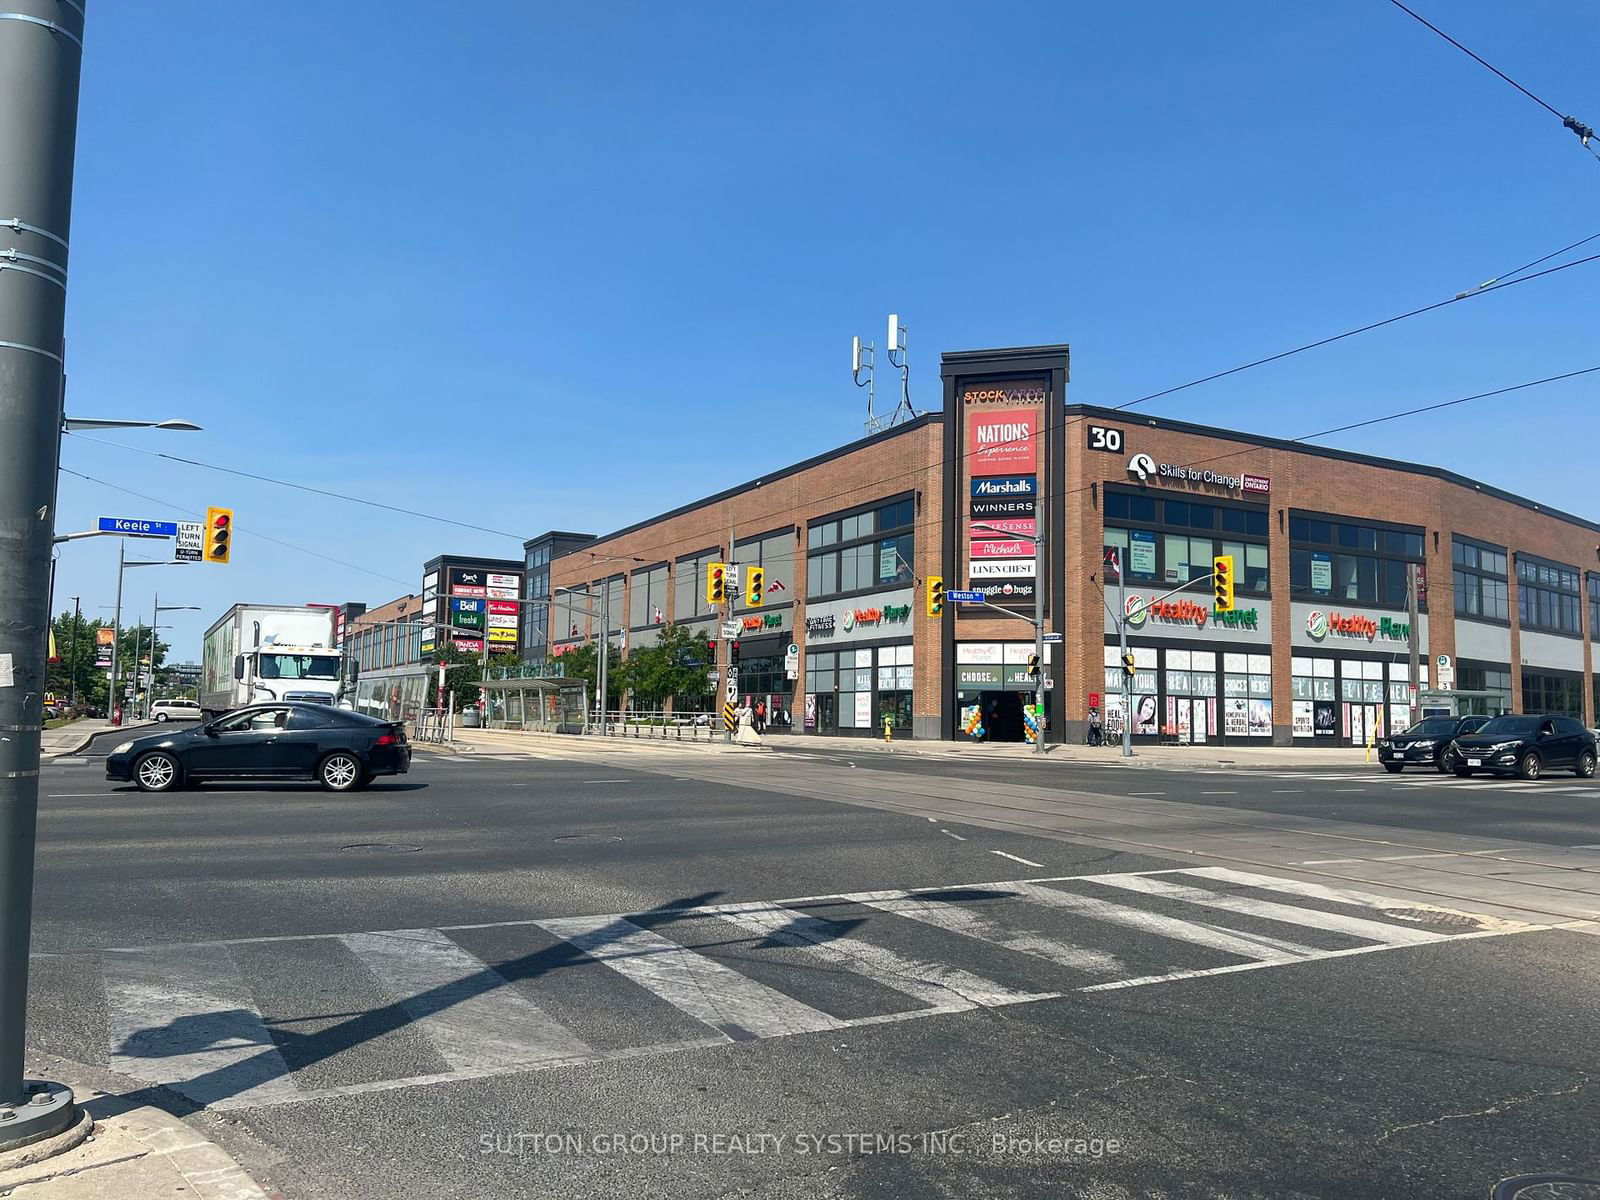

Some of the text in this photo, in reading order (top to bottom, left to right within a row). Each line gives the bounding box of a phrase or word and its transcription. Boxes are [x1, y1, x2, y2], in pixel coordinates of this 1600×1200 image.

[977, 423, 1030, 443] NATIONS
[1092, 427, 1121, 451] 30
[977, 445, 1030, 457] Experience
[1159, 463, 1240, 489] Skills for Change
[975, 480, 1032, 494] Marshalls
[1244, 481, 1269, 491] ONTARIO
[973, 502, 1034, 512] WINNERS
[115, 519, 151, 531] Keele
[181, 524, 200, 532] LEFT
[181, 532, 201, 540] TURN
[178, 540, 201, 548] SIGNAL
[973, 565, 1033, 574] LINEN CHEST
[972, 584, 1033, 595] snuggle bugz
[952, 591, 974, 600] Weston
[460, 600, 477, 611] Bell
[1151, 597, 1208, 624] Healthy
[853, 604, 912, 624] Healthy Planet
[1329, 611, 1377, 636] Healthy
[961, 672, 991, 682] CHOOSE
[1135, 673, 1155, 686] YOUR
[1348, 682, 1378, 698] LIFE
[1295, 717, 1310, 725] SPORTS
